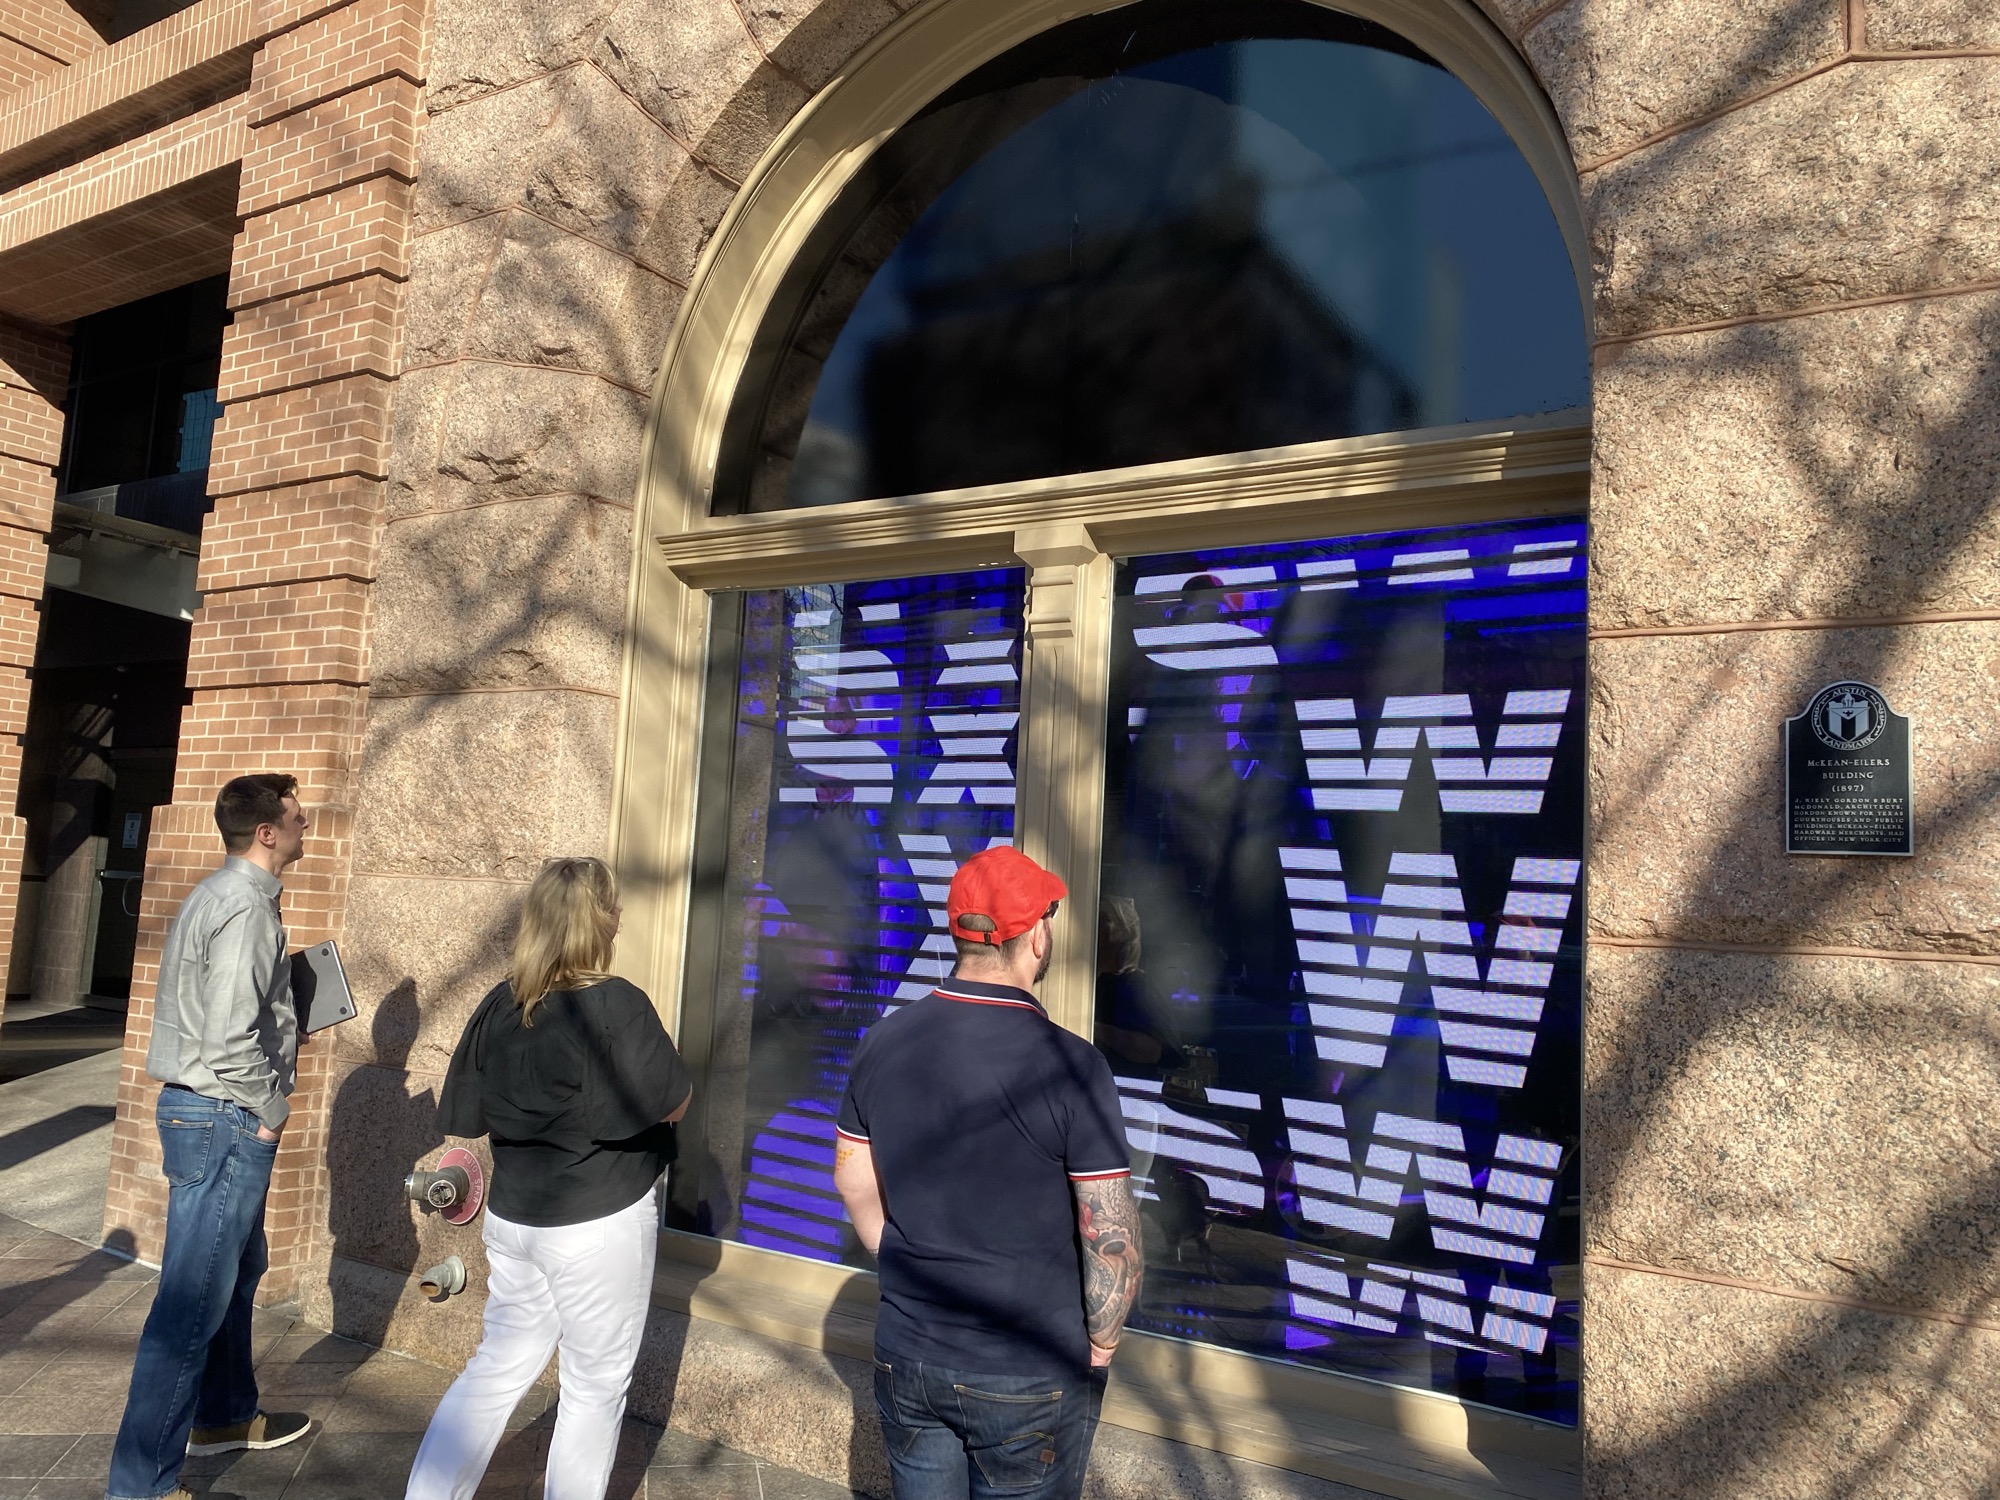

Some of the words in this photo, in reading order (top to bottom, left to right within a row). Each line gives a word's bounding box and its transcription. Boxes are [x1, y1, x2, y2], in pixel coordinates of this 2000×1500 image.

[1832, 687, 1867, 697] AUSTIN
[1823, 735, 1875, 750] LANDMARK
[1822, 771, 1874, 779] BUILDING
[1832, 784, 1864, 793] (1897)
[462, 1153, 478, 1173] AUTO
